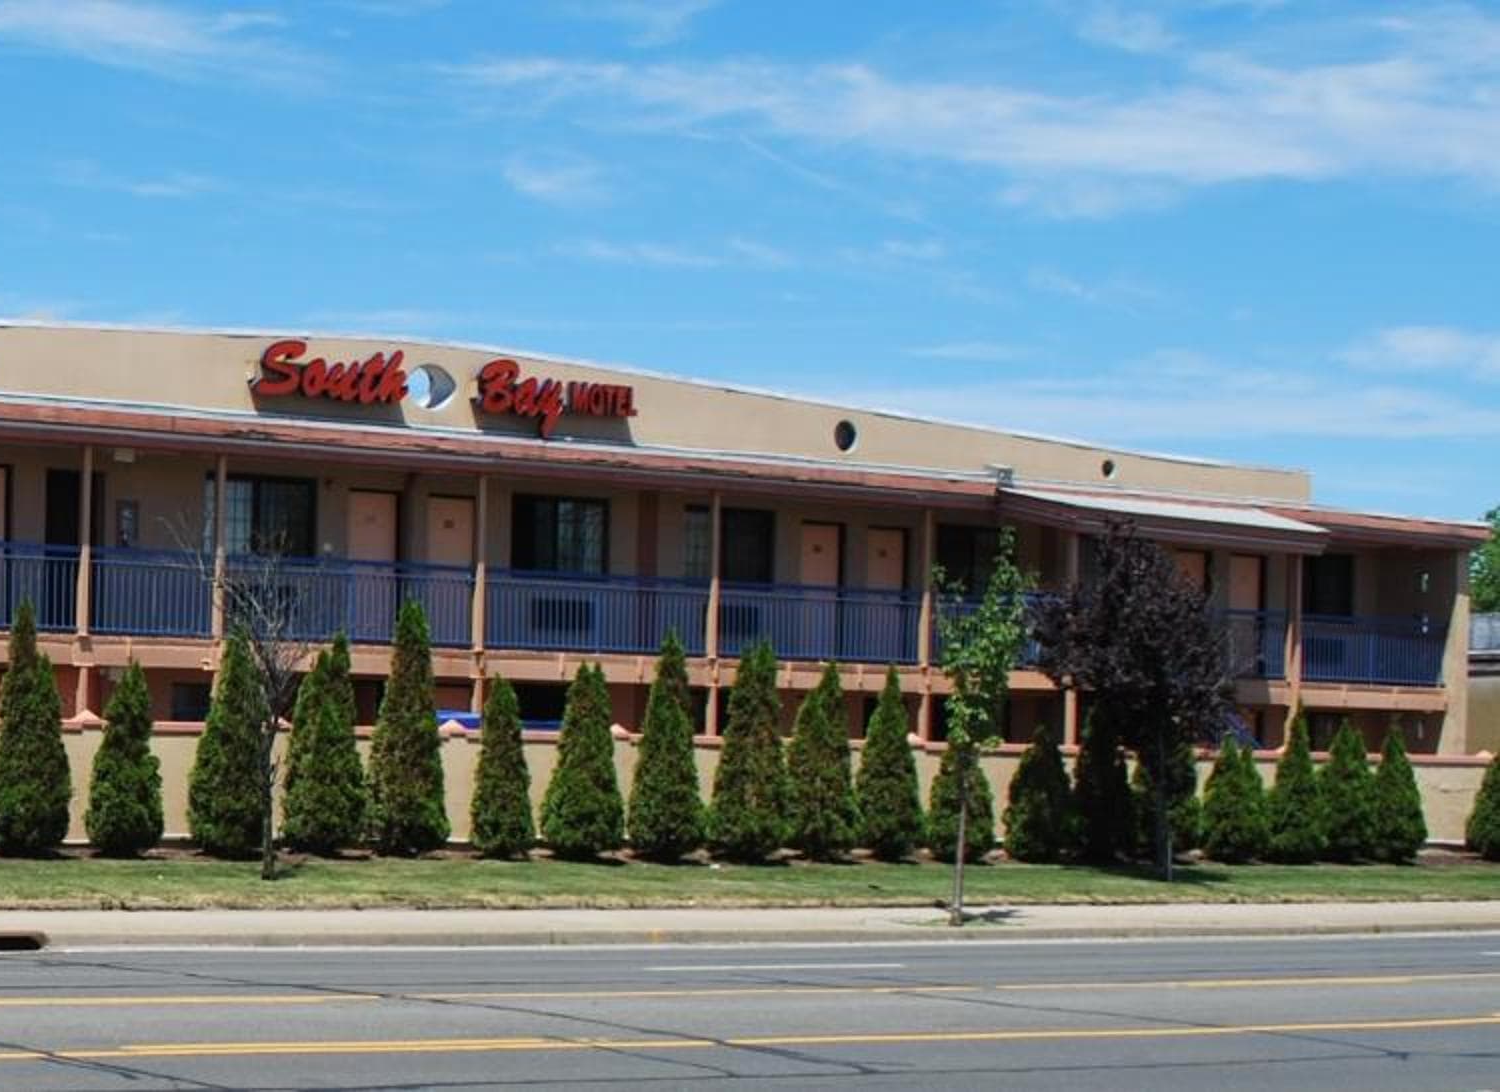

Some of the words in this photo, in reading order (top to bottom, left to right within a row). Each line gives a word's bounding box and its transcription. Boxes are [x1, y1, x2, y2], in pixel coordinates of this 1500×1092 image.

[254, 340, 409, 404] South
[477, 359, 564, 438] Bay
[566, 382, 638, 416] MOTEL
